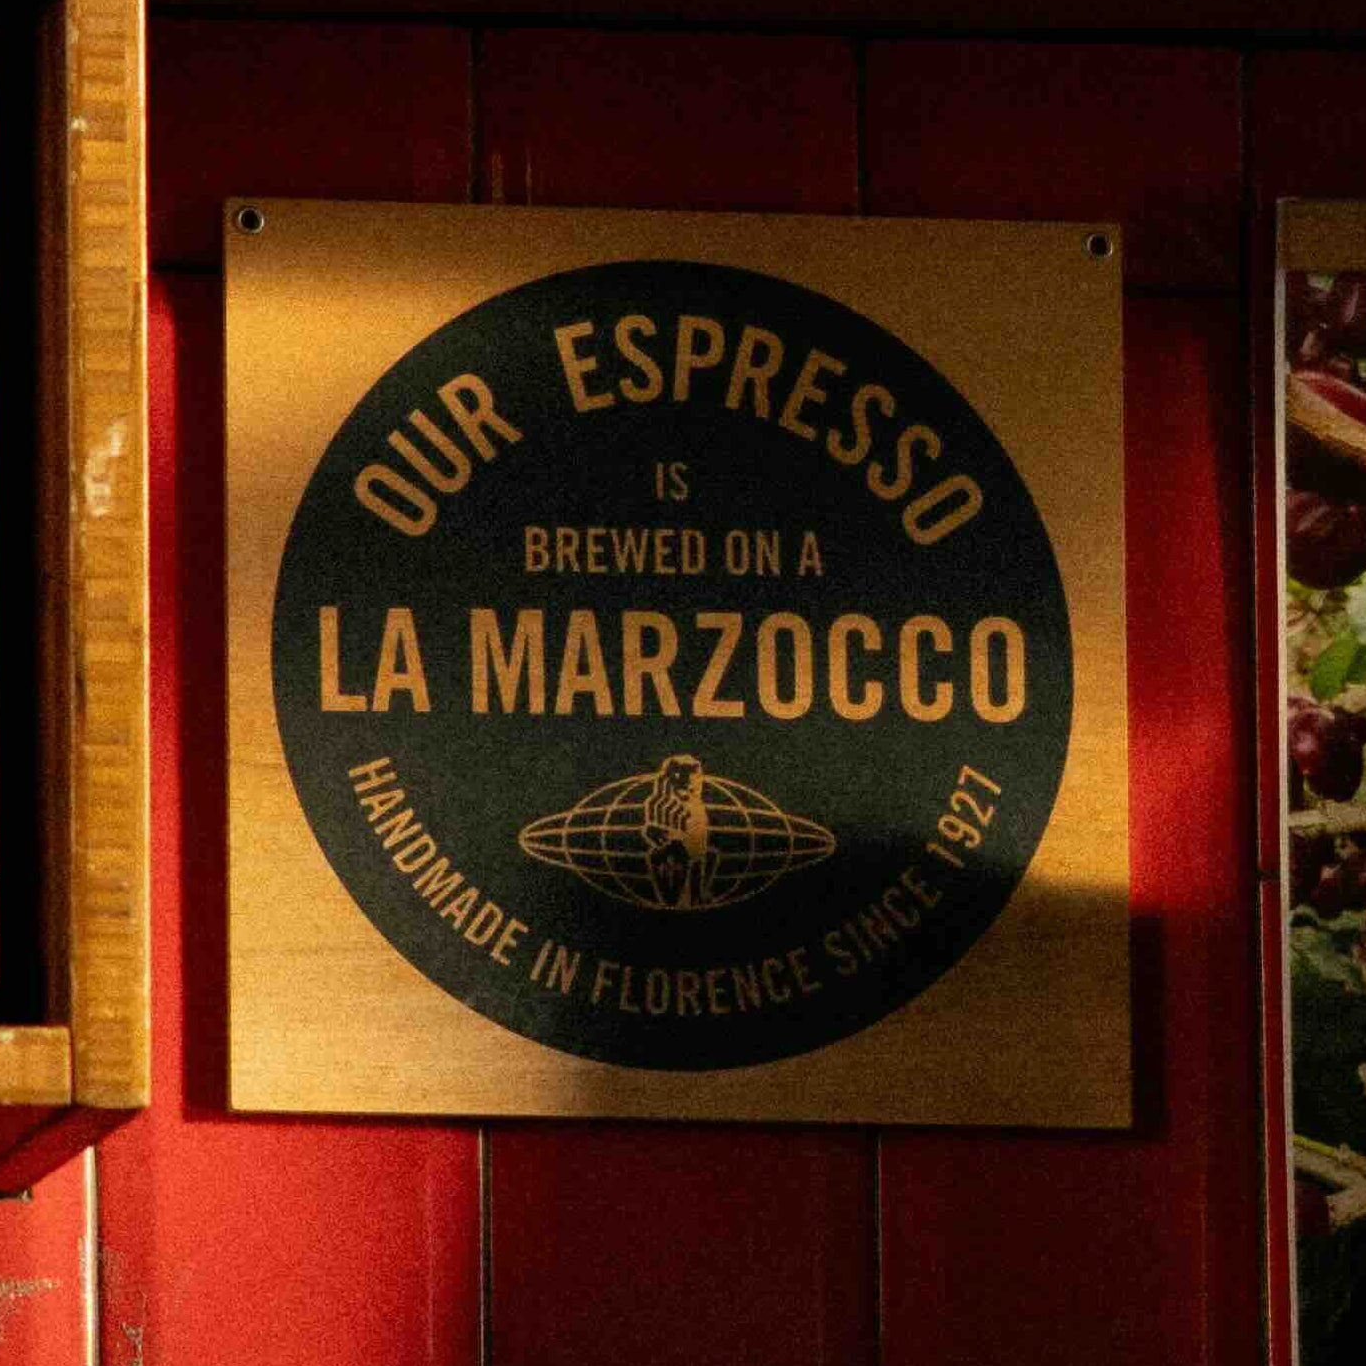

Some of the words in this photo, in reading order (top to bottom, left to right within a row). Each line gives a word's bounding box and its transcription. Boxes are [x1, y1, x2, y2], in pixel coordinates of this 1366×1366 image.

[354, 373, 522, 537] OUR
[554, 314, 984, 546] ESPRESSO
[655, 462, 689, 501] IS
[524, 526, 706, 576] BREWED
[725, 529, 780, 577] ON
[798, 531, 824, 577] A
[319, 606, 431, 713] LA
[470, 607, 1027, 723] MARZOCCO
[349, 756, 529, 965] HANDMADE
[530, 938, 577, 993] IN
[590, 958, 821, 1016] FLORENCE
[824, 865, 941, 977] SINCE
[927, 763, 1002, 870] 1927
